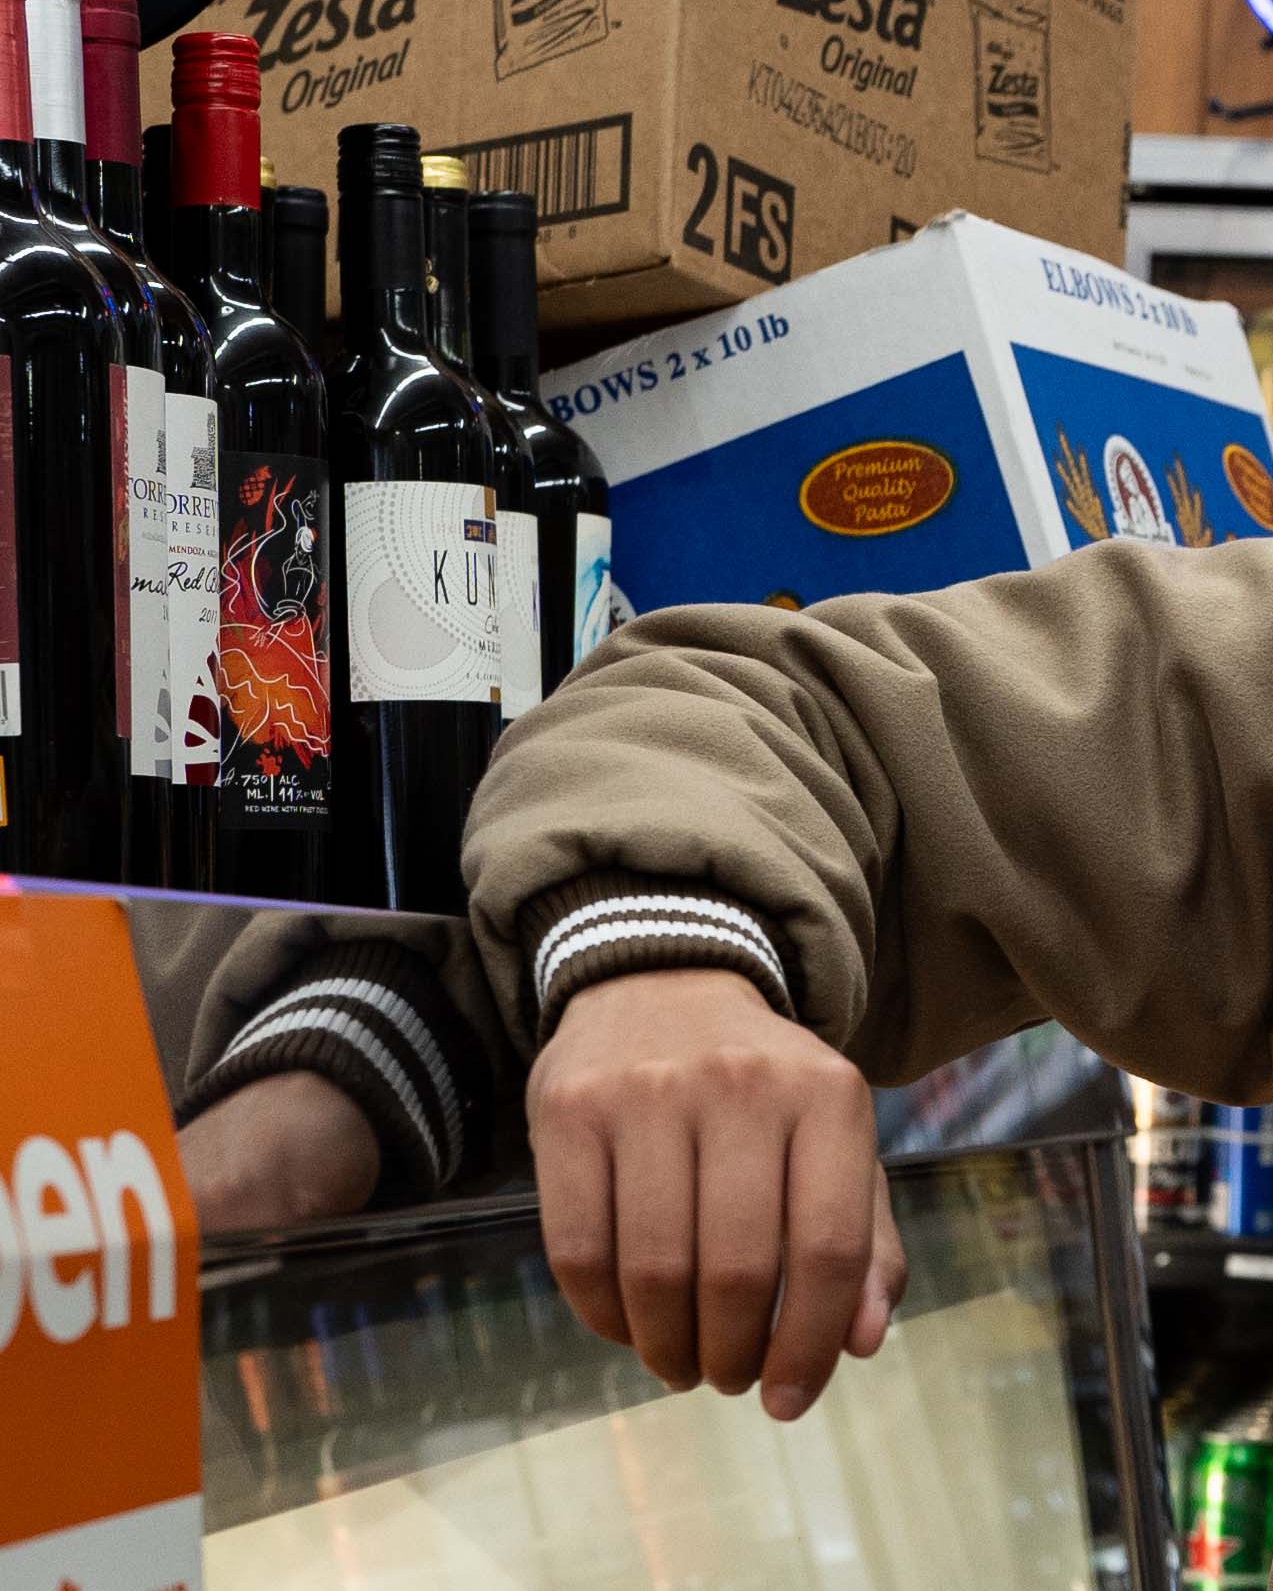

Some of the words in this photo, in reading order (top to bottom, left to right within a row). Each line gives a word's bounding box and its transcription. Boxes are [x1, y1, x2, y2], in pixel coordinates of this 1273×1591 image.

[280, 38, 411, 115] Original
[820, 33, 918, 99] Original
[986, 62, 1040, 100] Zesta
[1039, 257, 1136, 316] ELBOWS
[665, 352, 687, 381] 2
[691, 346, 712, 371] x
[716, 324, 753, 360] 10
[756, 313, 790, 345] lb
[833, 457, 923, 481] Premium
[842, 476, 917, 503] Quality
[854, 502, 912, 524] Pasta
[166, 561, 202, 593] Red
[240, 774, 268, 787] 750
[0, 1127, 177, 1351] en
